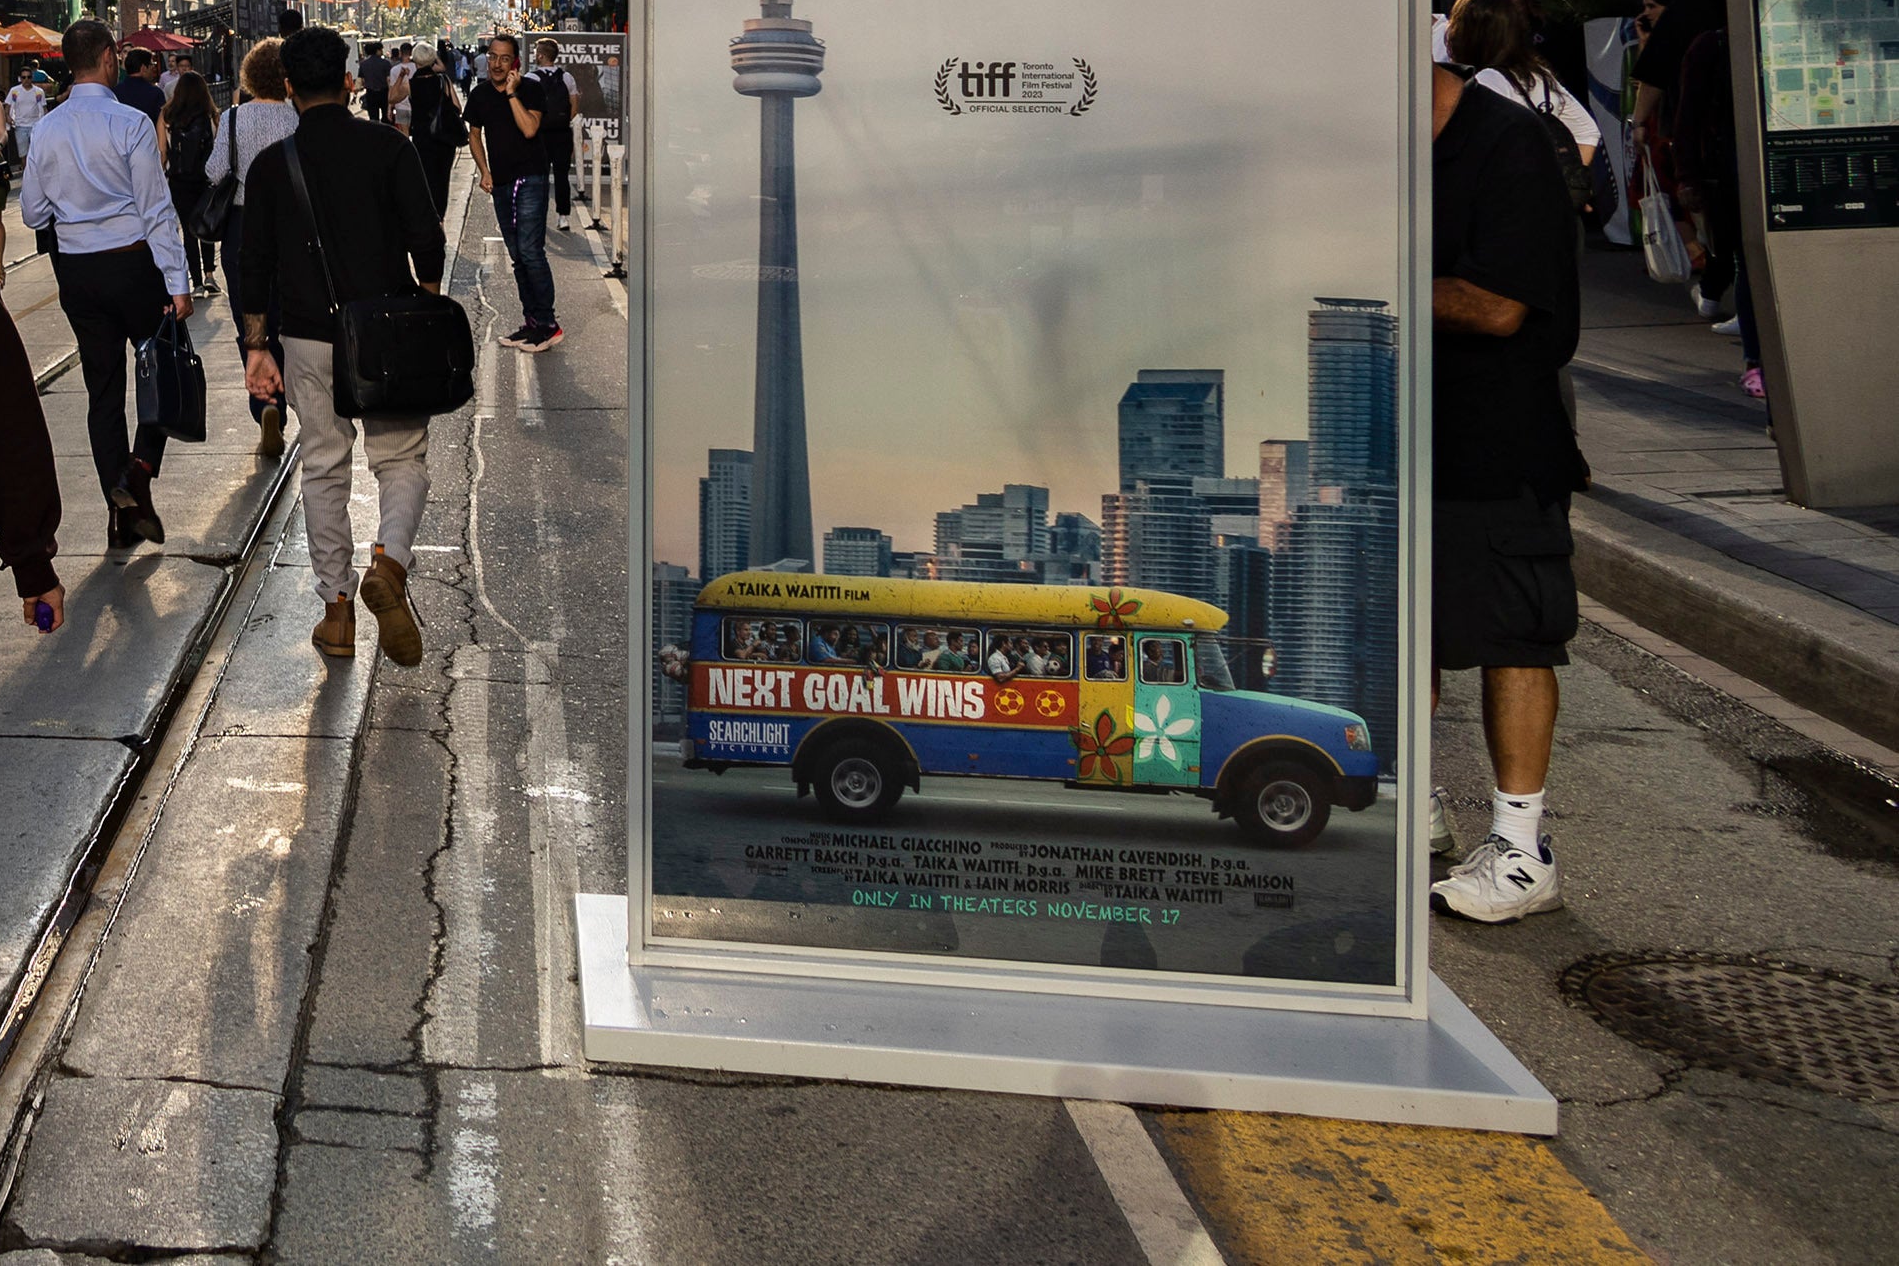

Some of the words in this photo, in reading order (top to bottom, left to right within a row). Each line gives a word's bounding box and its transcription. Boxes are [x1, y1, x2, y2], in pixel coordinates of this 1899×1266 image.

[566, 23, 579, 33] 40
[557, 44, 588, 55] AKE
[588, 44, 621, 55] THE
[957, 61, 1016, 98] tiff
[1021, 62, 1054, 70] Toronto
[1021, 71, 1075, 80] International
[1021, 81, 1040, 90] Film
[1041, 81, 1073, 90] Festival
[1021, 90, 1043, 99] 2023
[969, 105, 1009, 114] OFFICIAL
[1012, 105, 1062, 114] SELECTION
[727, 584, 736, 596] A
[738, 582, 782, 598] TAIKA
[785, 583, 842, 600] WAITITI
[844, 589, 871, 602] FILM
[708, 667, 796, 708] NEXT
[802, 671, 891, 714] GOAL
[896, 676, 986, 719] WINS
[708, 720, 791, 744] SEARCHLIGHT
[710, 744, 789, 755] PICTURES
[832, 833, 897, 851] MICHAEL
[900, 838, 982, 855] GIACCHINO
[990, 841, 1029, 851] PRODUCED
[1029, 844, 1115, 863] JONATHAN
[1210, 857, 1250, 871] p.g.a.
[744, 845, 810, 862] GARRETT
[867, 855, 905, 870] p.g.a.
[913, 855, 958, 872] TAIKA
[1027, 864, 1066, 878] p.g.a.
[1075, 864, 1117, 881] MIKE
[1119, 866, 1166, 883] BRETT
[1175, 870, 1220, 887] STEVE
[1224, 873, 1295, 891] JAMISON
[1506, 865, 1535, 891] N
[855, 869, 900, 885] TAIKA
[904, 872, 959, 889] WAITITI
[964, 878, 971, 890] &
[976, 876, 1009, 892] IAIN
[1013, 879, 1071, 896] MORRIS
[1115, 885, 1161, 902] TAIKA
[1164, 888, 1224, 904] WAITITI
[852, 889, 899, 908] ONLY
[909, 893, 932, 910] IN
[940, 895, 1038, 917] THEATERS
[1047, 900, 1152, 925] NOVEMBER
[1161, 908, 1181, 925] 17
